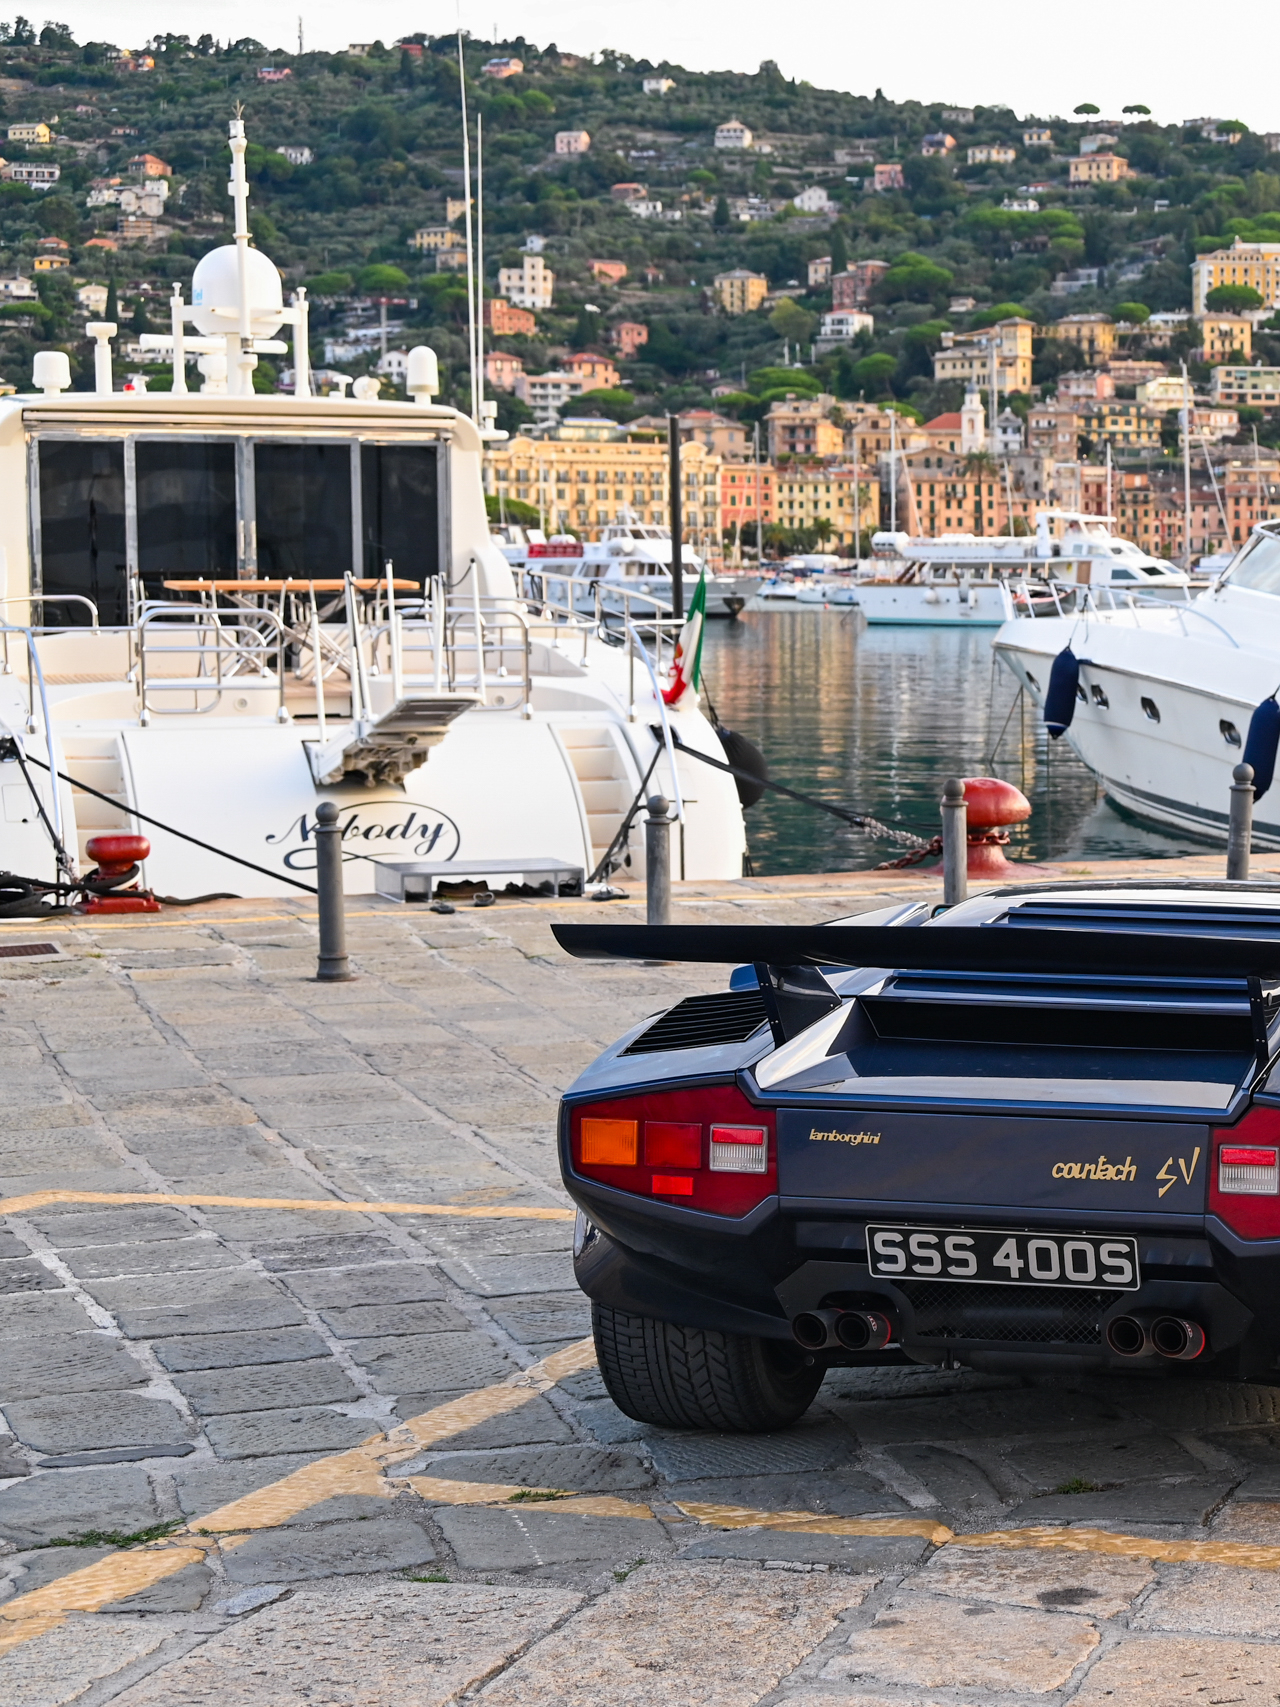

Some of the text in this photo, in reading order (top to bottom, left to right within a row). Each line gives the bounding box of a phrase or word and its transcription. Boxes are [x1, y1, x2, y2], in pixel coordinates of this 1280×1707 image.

[265, 812, 449, 856] Nbody
[809, 1128, 881, 1146] lamborghini
[1051, 1146, 1201, 1198] countach SV
[873, 1231, 1133, 1284] SSS 400S
